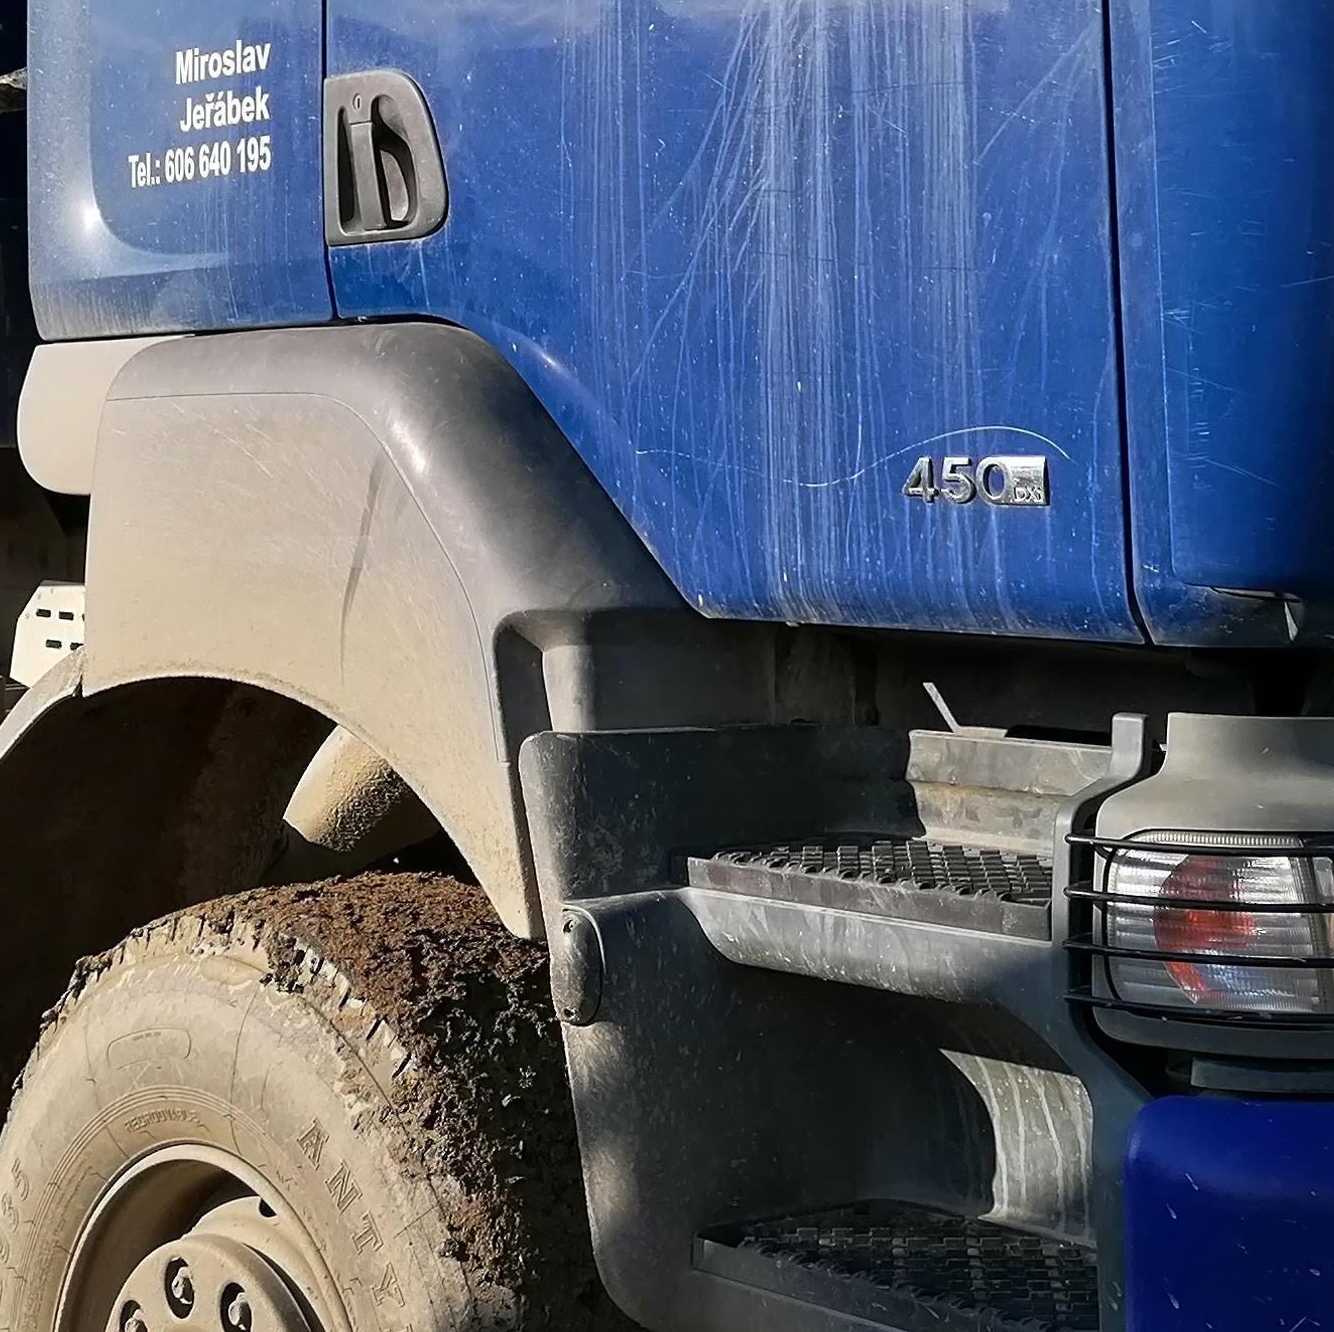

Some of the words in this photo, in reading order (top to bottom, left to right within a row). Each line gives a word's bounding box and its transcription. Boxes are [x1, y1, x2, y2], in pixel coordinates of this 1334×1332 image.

[175, 40, 271, 85] Miroslav
[180, 85, 270, 132] Jeřábek
[128, 153, 161, 188] Tel.:
[165, 146, 195, 183] 606
[199, 140, 231, 179] 640
[237, 135, 271, 172] 195
[902, 456, 1008, 504] 450
